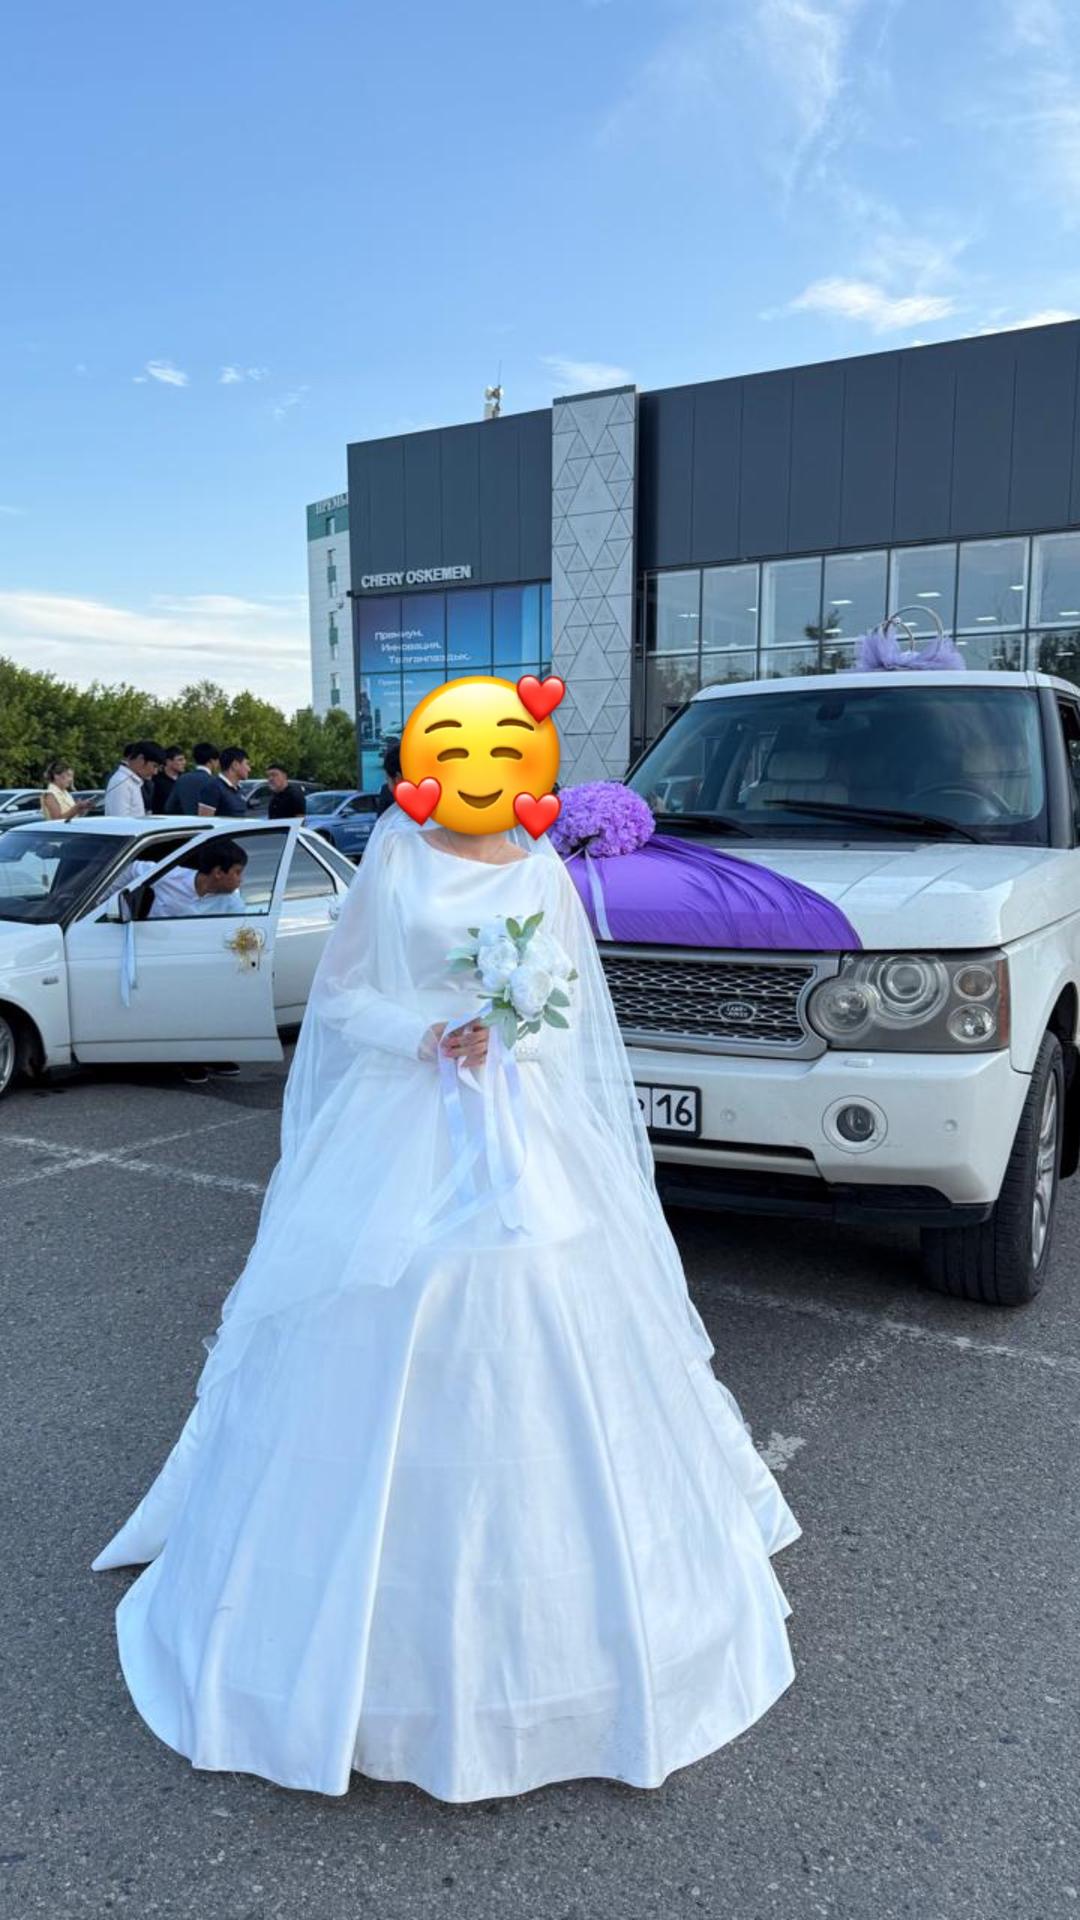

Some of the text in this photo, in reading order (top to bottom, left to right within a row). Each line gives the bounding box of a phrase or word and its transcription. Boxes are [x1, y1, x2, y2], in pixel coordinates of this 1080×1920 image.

[361, 565, 472, 588] CHERY OSKEMEN
[656, 1094, 692, 1126] 16
